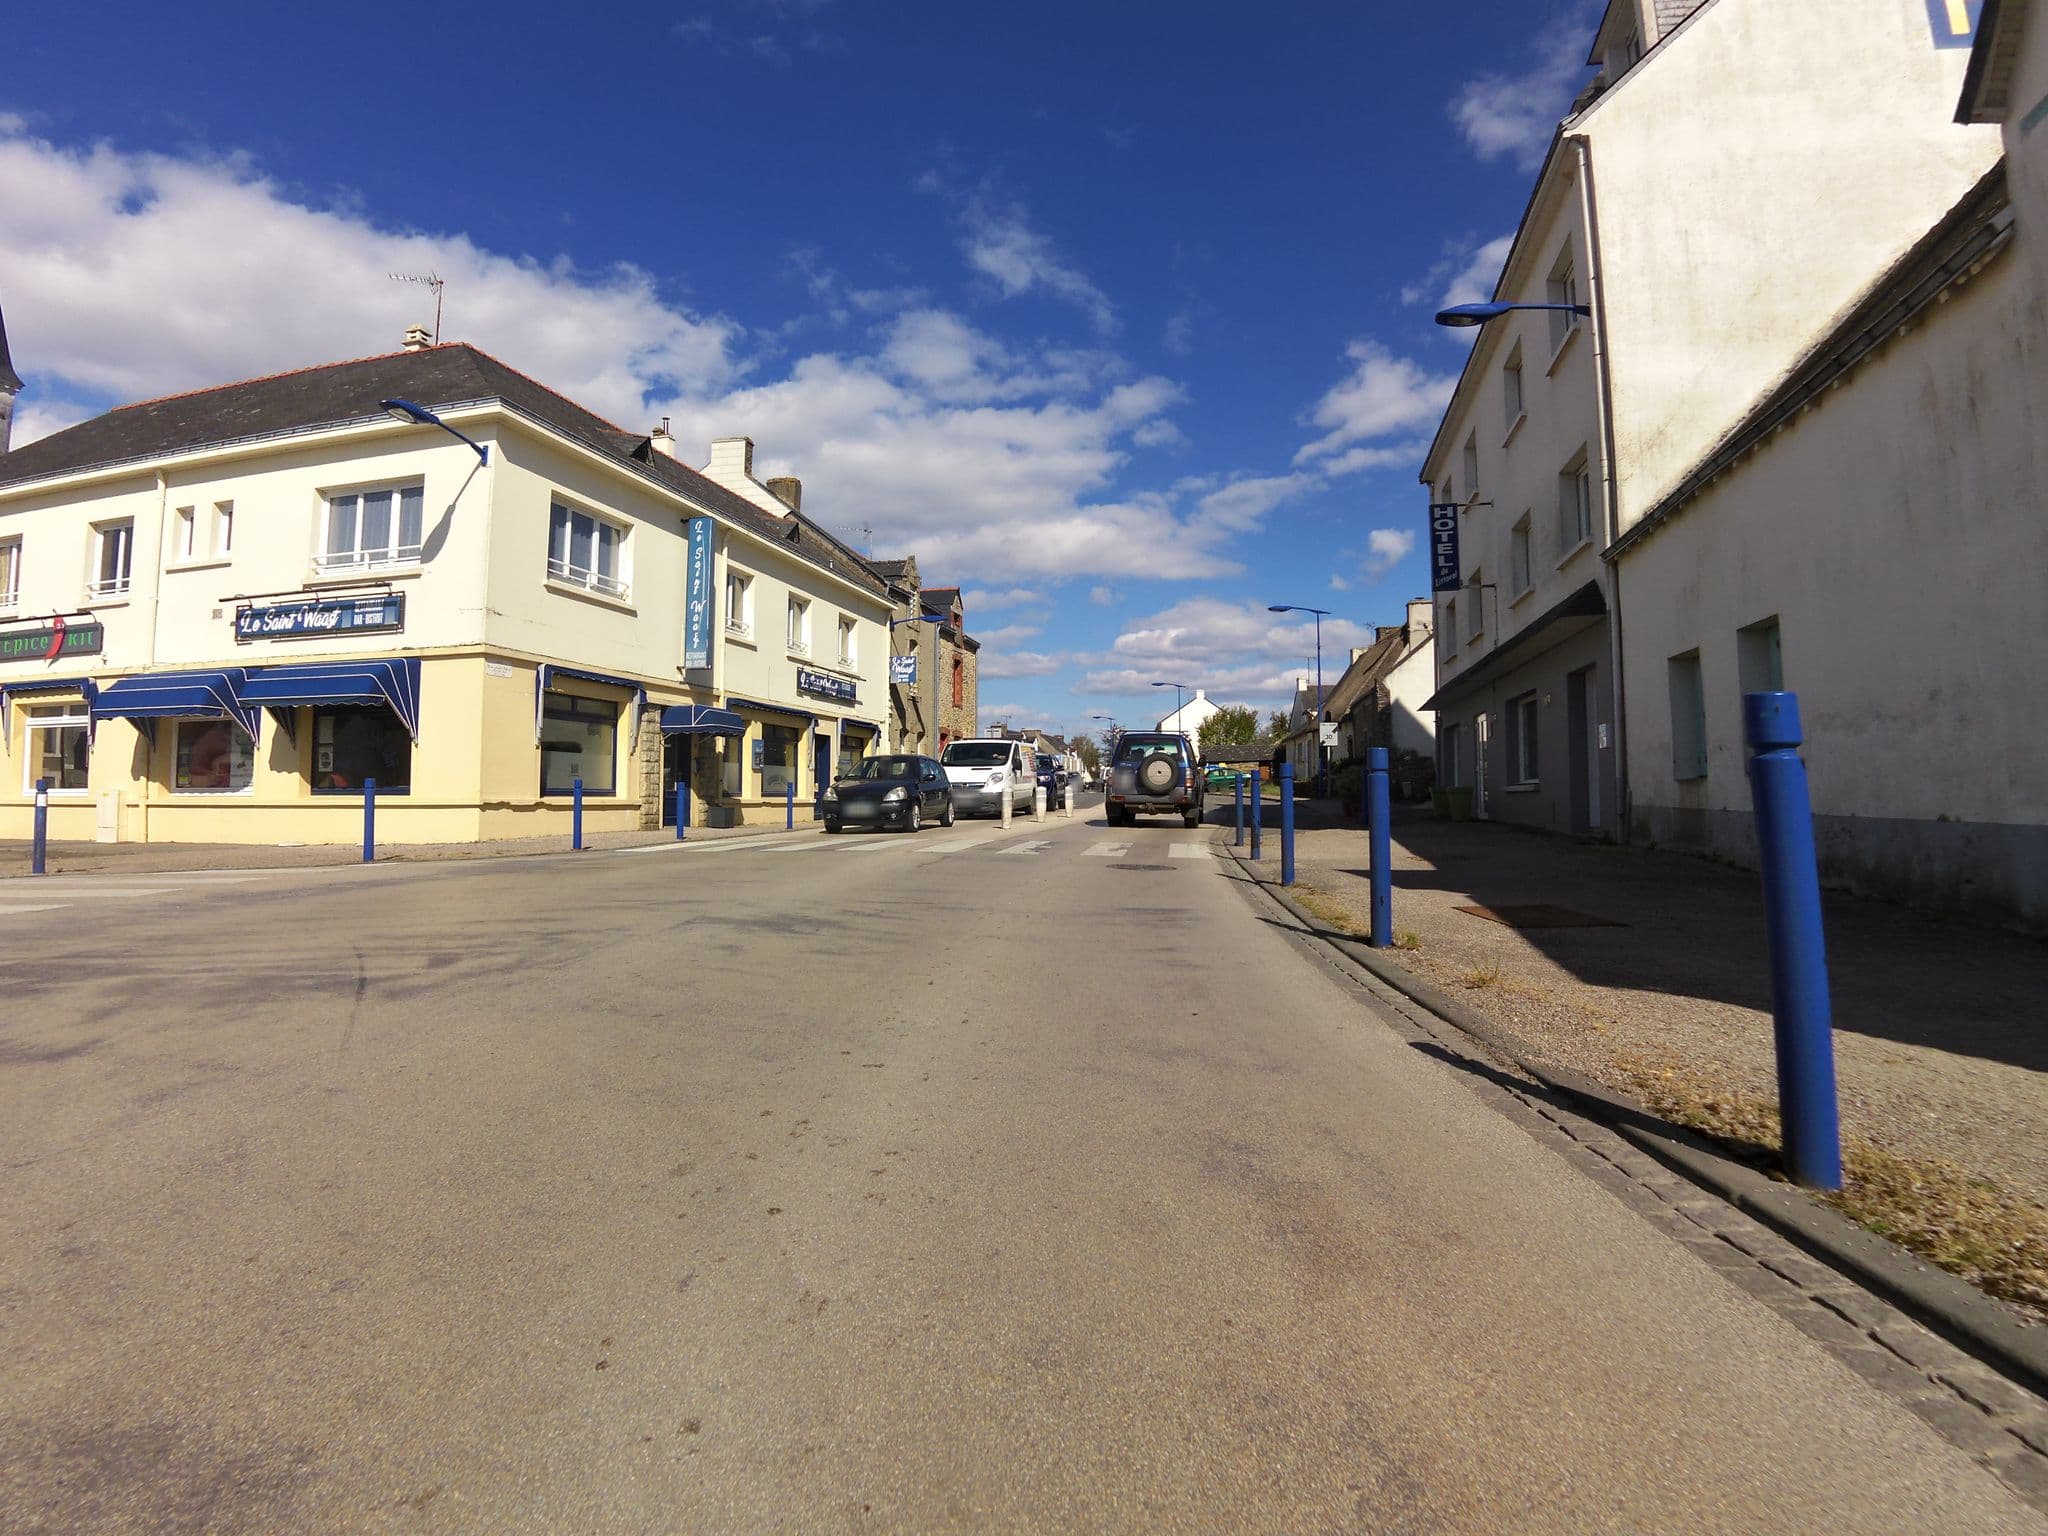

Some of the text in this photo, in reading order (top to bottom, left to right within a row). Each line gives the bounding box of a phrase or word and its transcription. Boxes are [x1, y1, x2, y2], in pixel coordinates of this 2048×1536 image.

[1433, 506, 1455, 568] HOTEL
[240, 604, 342, 633] Le Saint Waast
